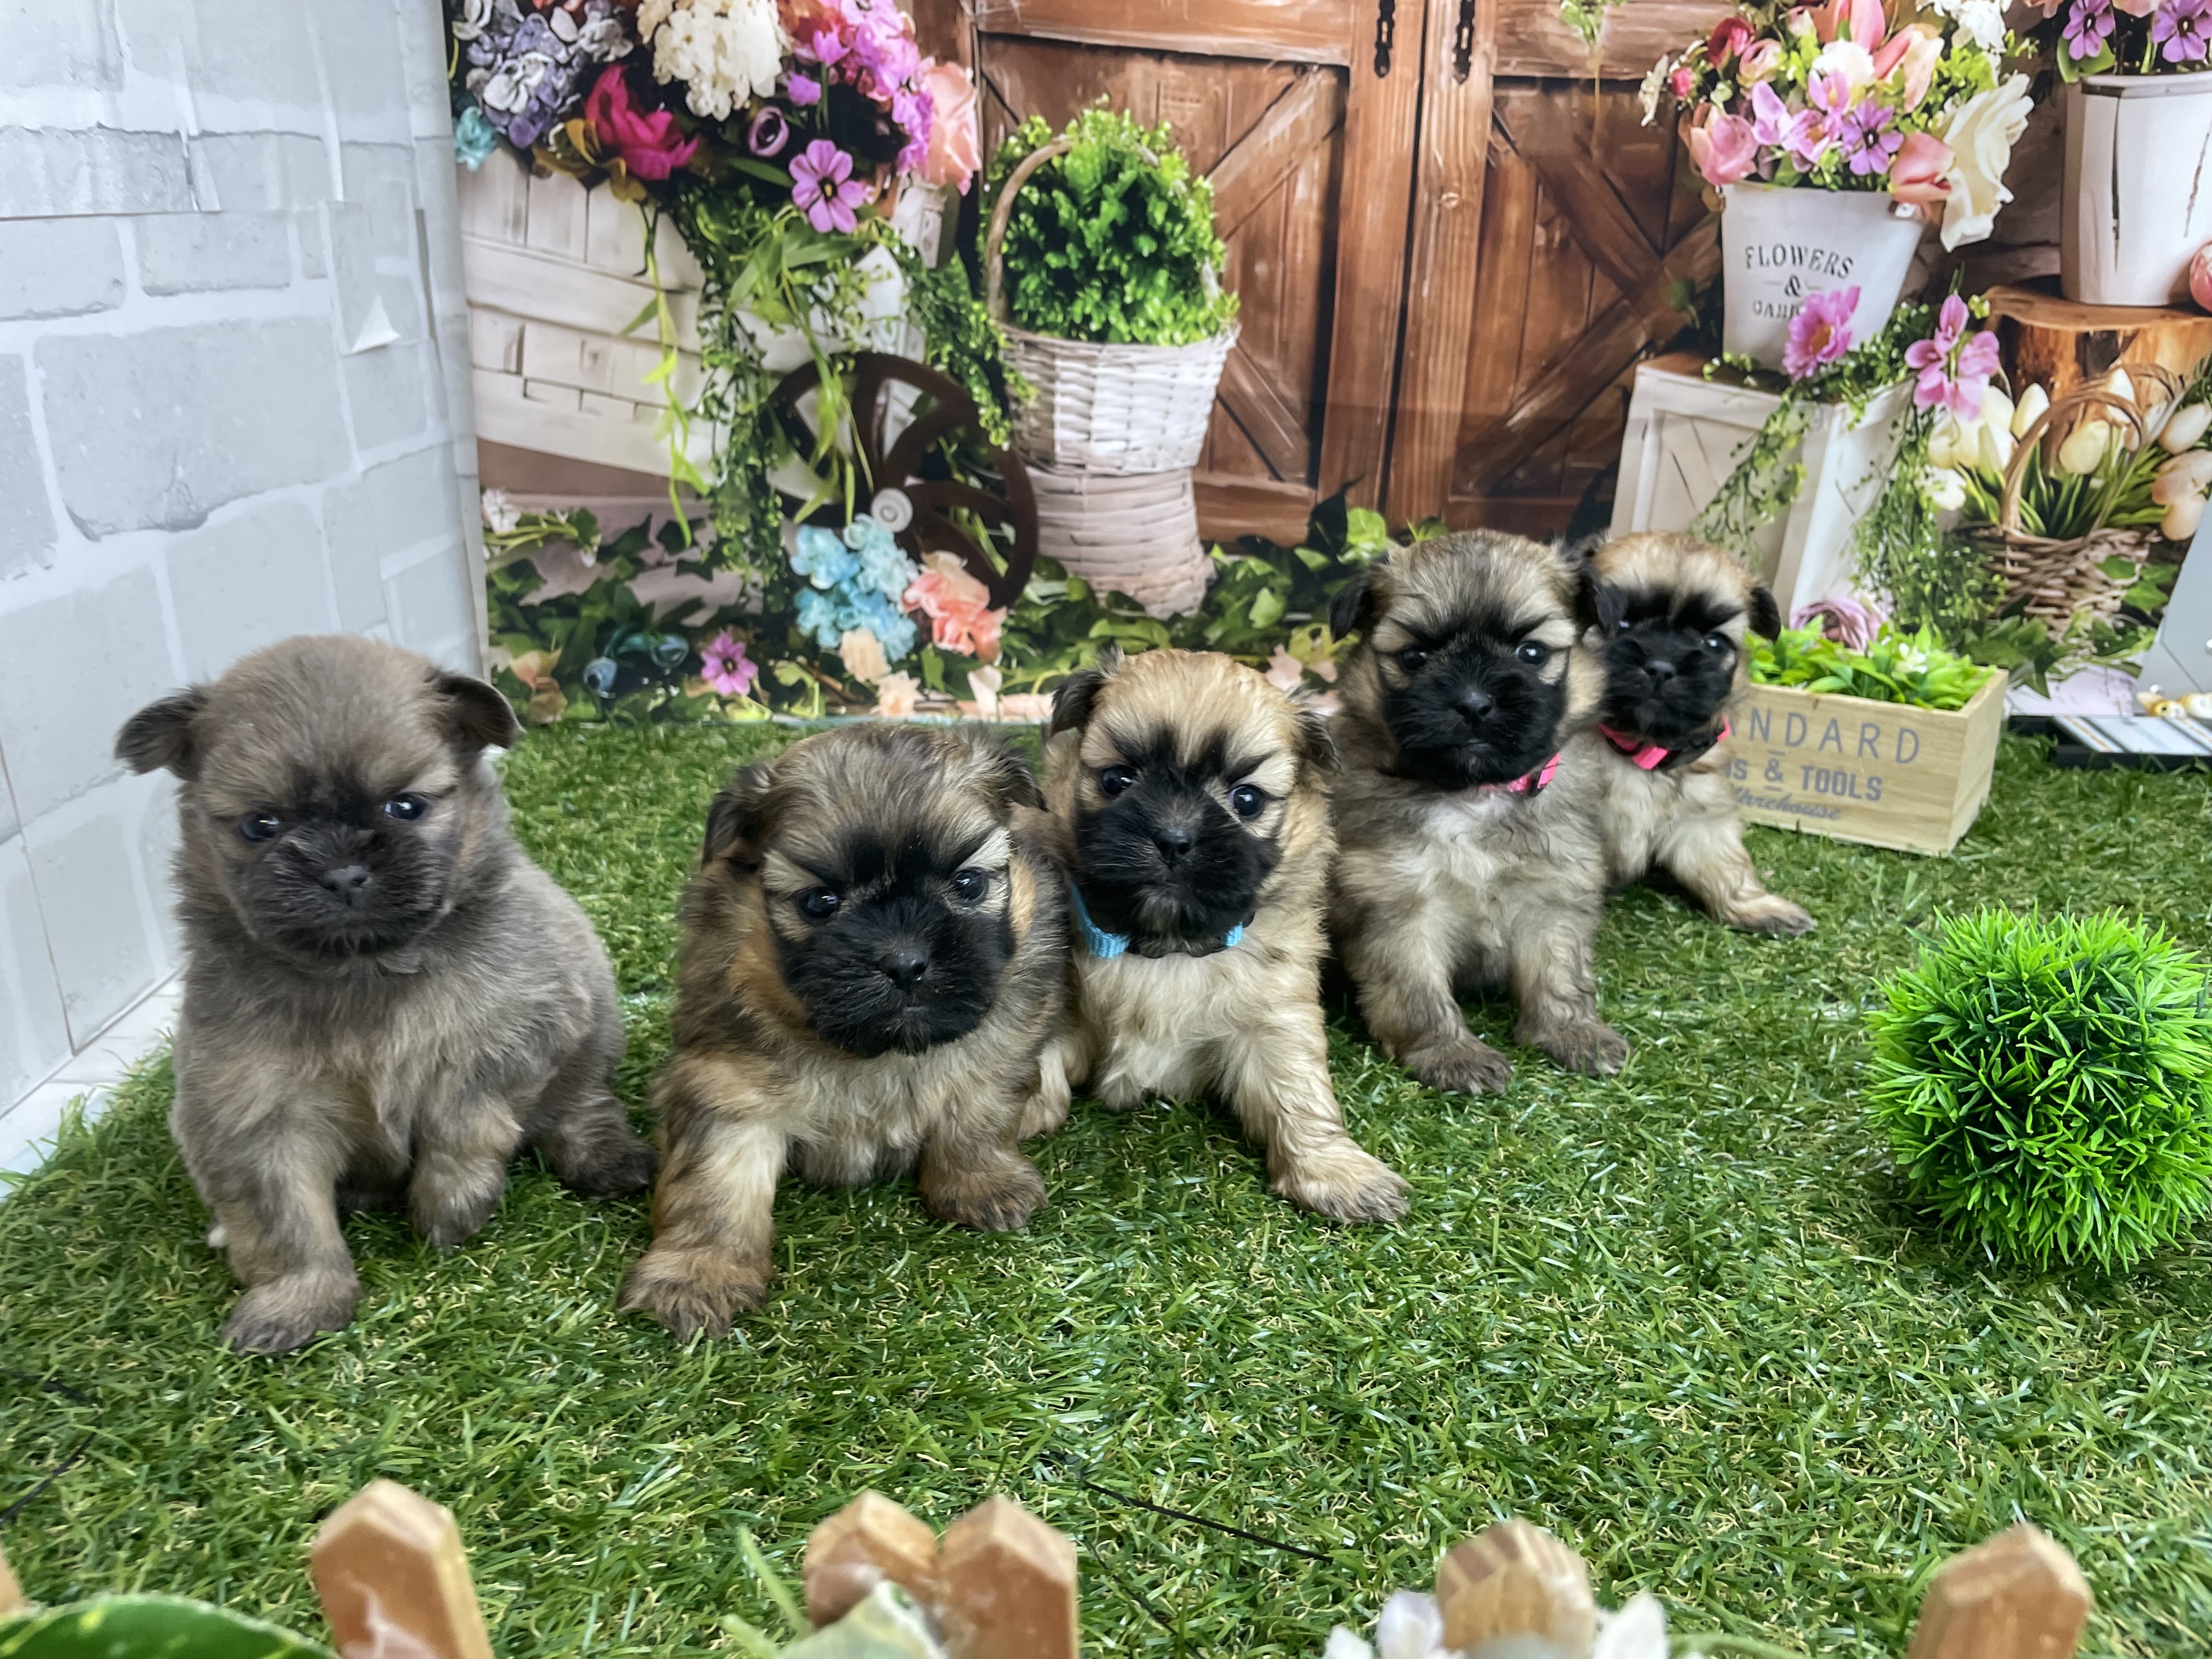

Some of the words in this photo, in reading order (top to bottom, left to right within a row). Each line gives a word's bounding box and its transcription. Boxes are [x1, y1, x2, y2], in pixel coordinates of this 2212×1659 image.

[1745, 244, 1854, 279] FLOWERS
[1784, 274, 1801, 297] &
[1764, 758, 1784, 783] &
[1801, 765, 1883, 801] TOOLS
